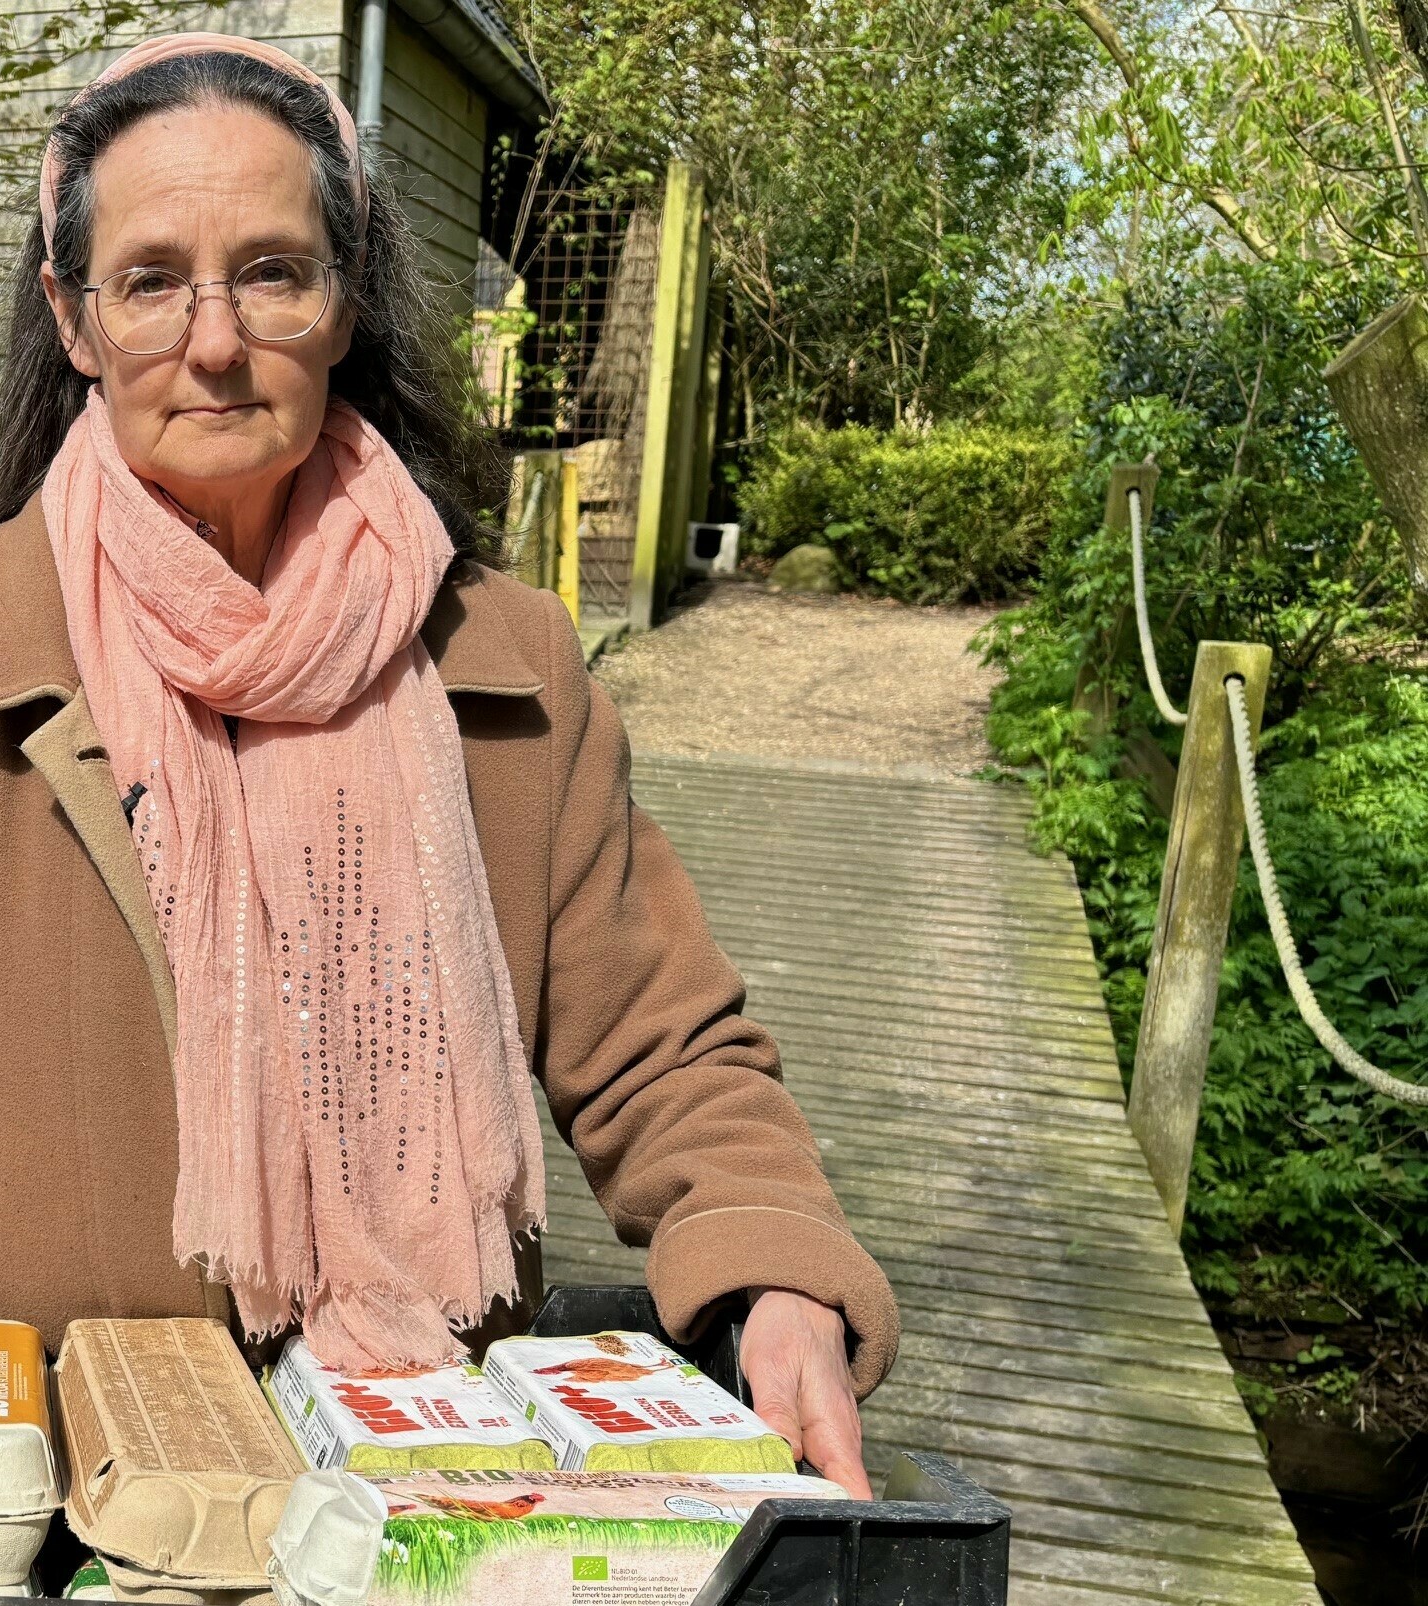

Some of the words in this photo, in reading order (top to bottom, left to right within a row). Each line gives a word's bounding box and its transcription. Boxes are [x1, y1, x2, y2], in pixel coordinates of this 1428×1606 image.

[430, 1398, 469, 1429] EIEREN
[477, 1418, 501, 1428] 10
[634, 1397, 677, 1428] BIOLOGISCHE
[655, 1400, 702, 1427] EIEREN
[709, 1416, 732, 1425] 10
